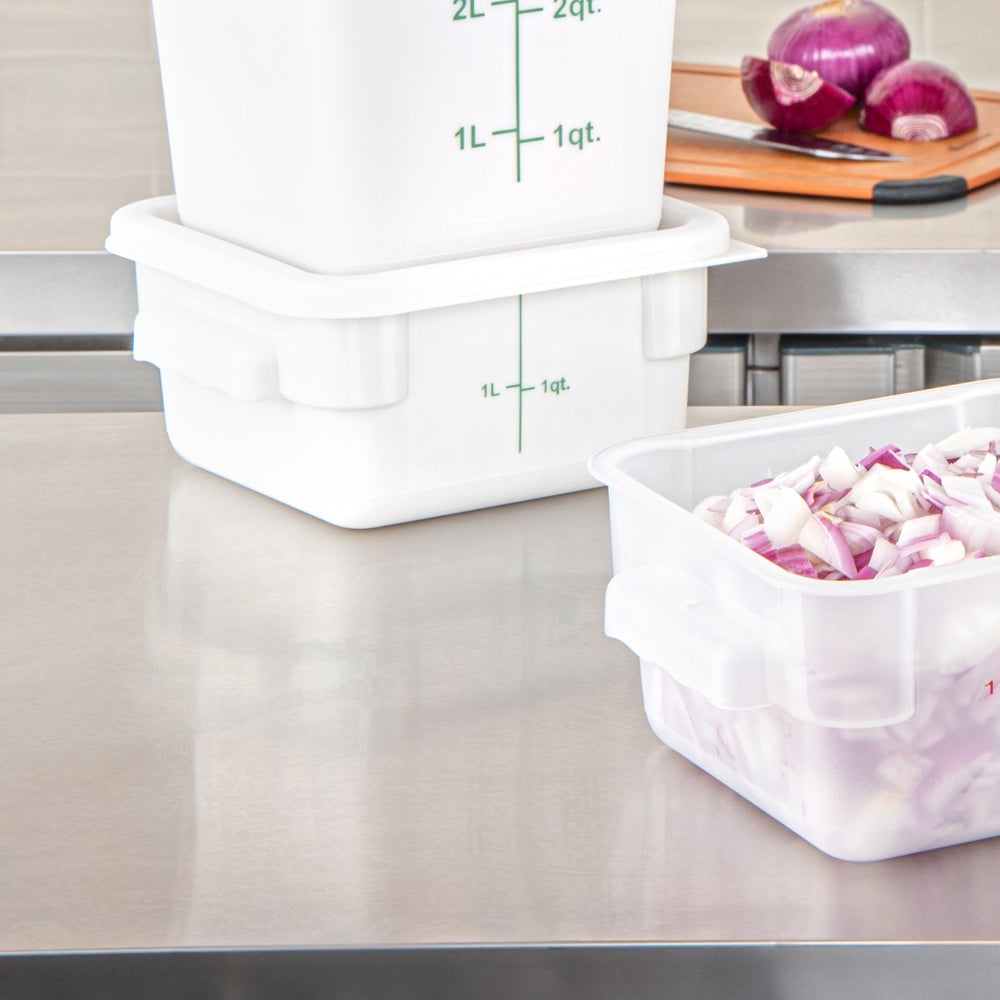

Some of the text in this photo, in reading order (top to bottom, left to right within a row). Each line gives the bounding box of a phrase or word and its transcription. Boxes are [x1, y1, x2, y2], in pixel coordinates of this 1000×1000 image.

[454, 125, 486, 150] 1L
[553, 122, 601, 150] 1qt.
[480, 382, 500, 397] 1L
[540, 376, 571, 396] 1qt.
